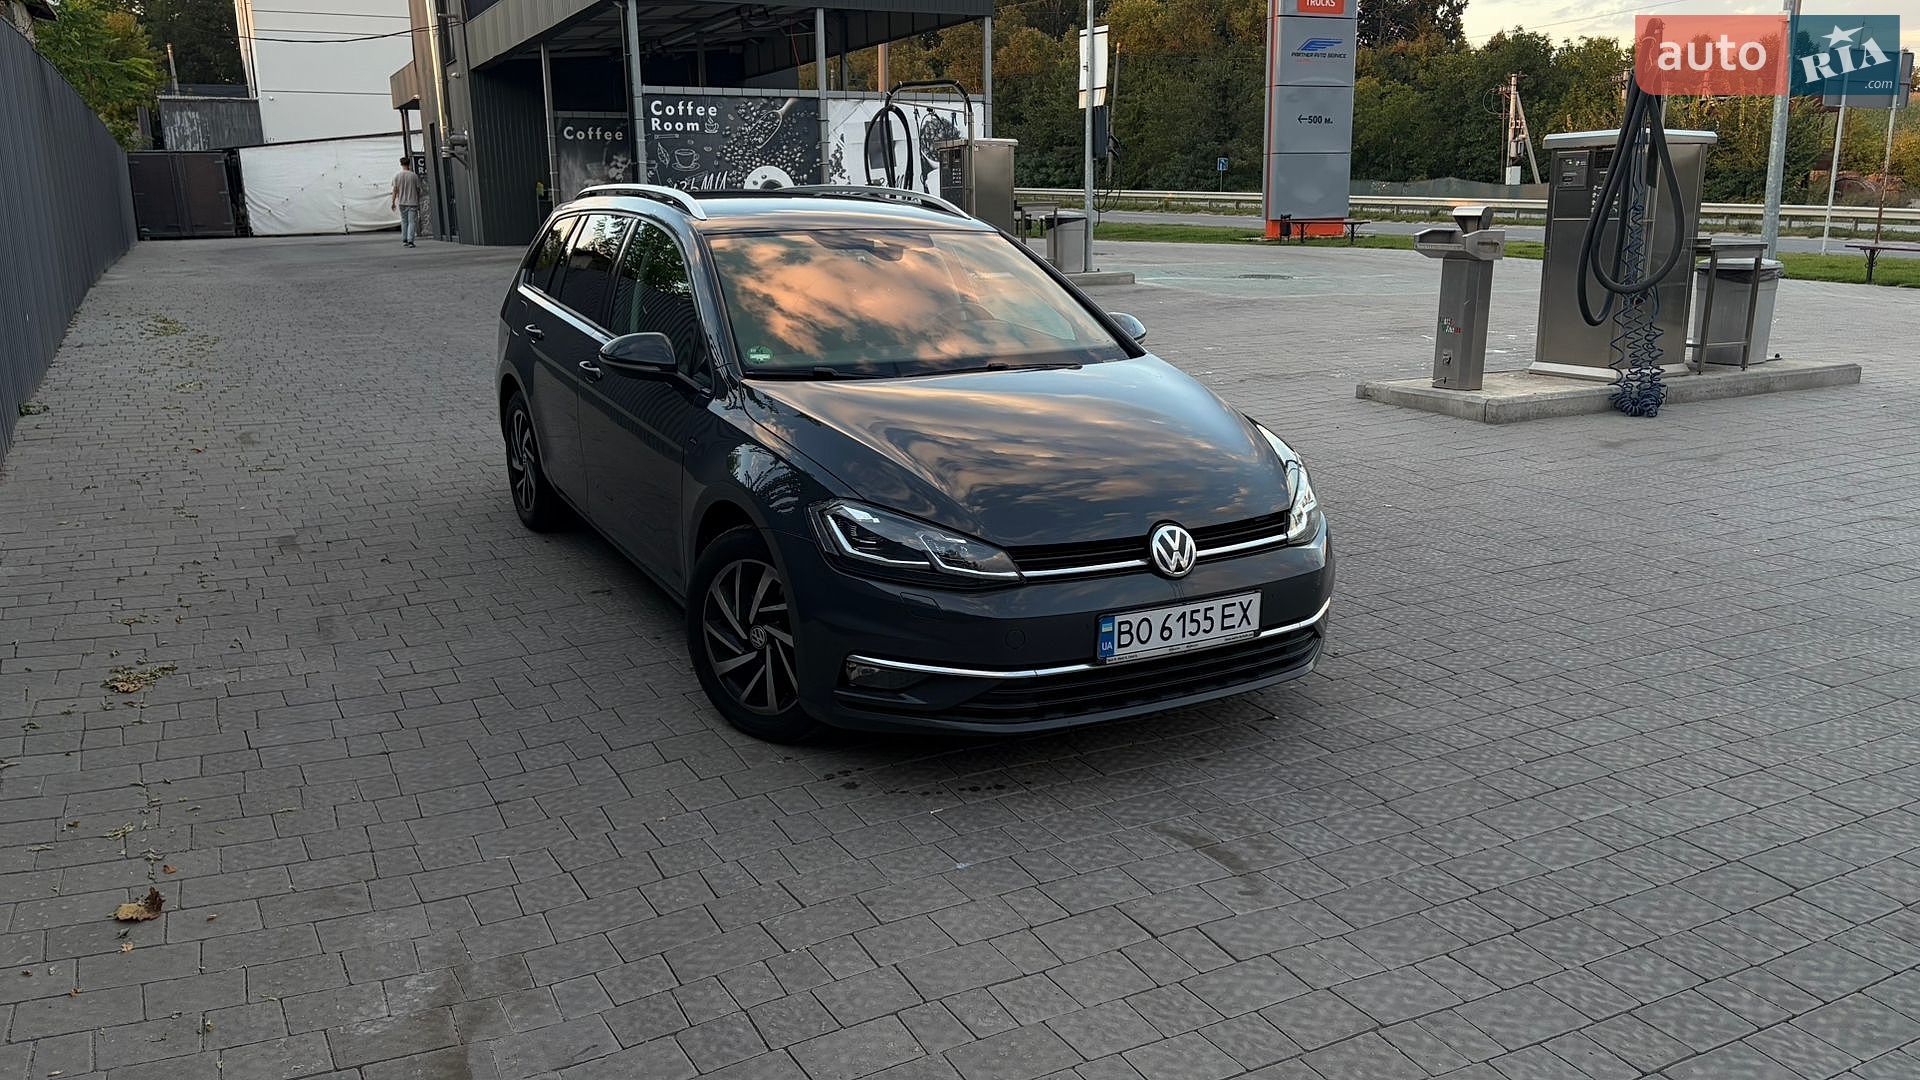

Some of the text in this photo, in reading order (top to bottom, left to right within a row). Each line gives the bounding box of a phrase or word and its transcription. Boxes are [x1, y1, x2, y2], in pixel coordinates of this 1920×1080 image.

[651, 100, 717, 116] Coffee
[651, 117, 700, 131] Room
[1308, 115, 1323, 124] 500
[563, 126, 624, 140] Coffee
[1117, 599, 1254, 649] BO 6155 EX
[1101, 641, 1113, 651] UA
